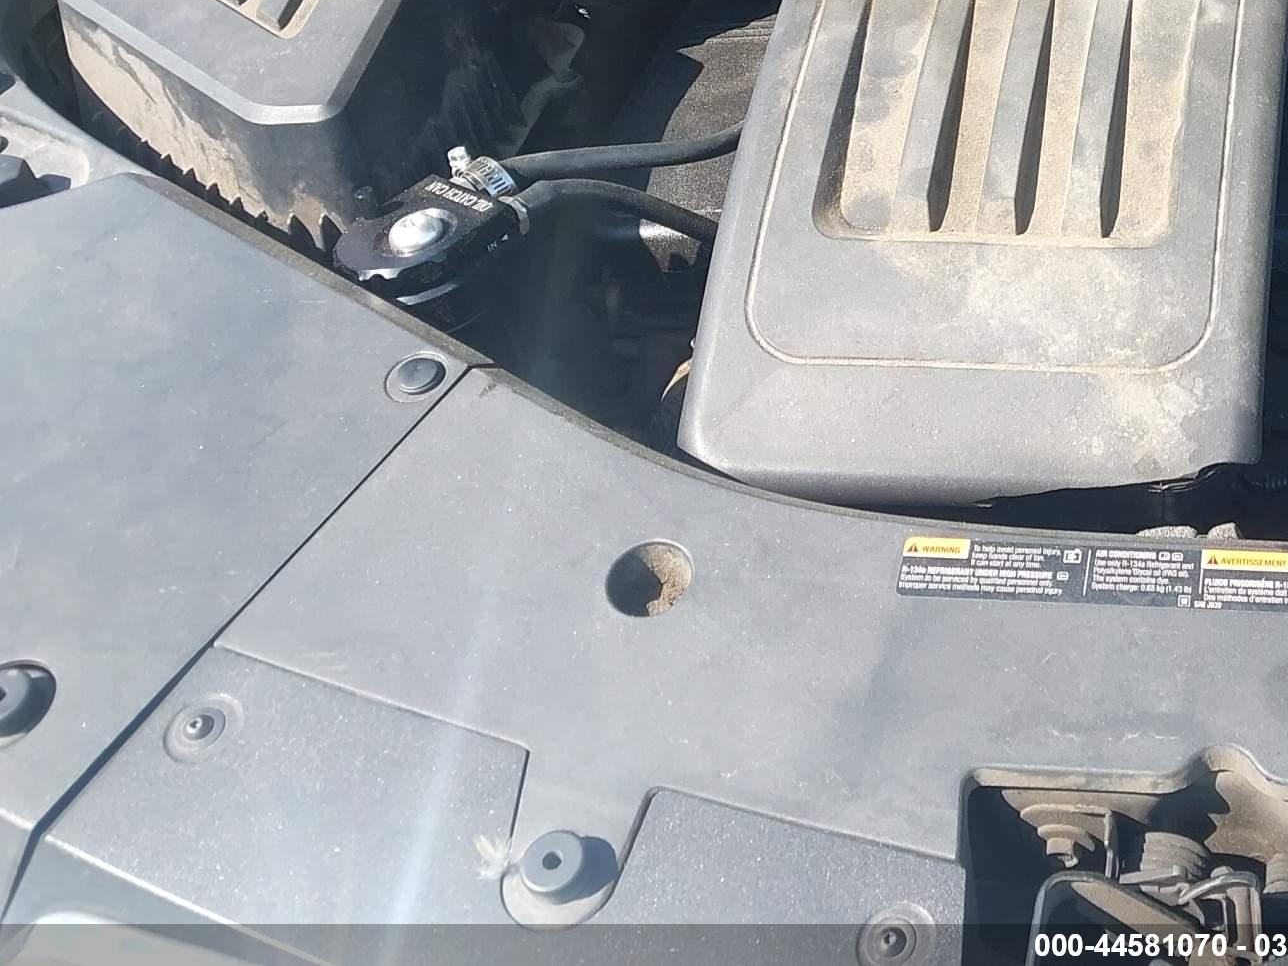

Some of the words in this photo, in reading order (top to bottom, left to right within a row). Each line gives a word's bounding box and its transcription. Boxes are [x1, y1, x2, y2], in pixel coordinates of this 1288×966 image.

[424, 181, 450, 195] CAN
[442, 188, 478, 207] CATCH
[472, 199, 494, 212] OIL
[486, 240, 498, 253] IN
[922, 545, 961, 554] WARNING
[1015, 547, 1042, 555] personal
[1096, 550, 1108, 558] AIR
[1109, 550, 1156, 560] CONDITIONING
[1220, 557, 1287, 567] AVERTISSEMENT
